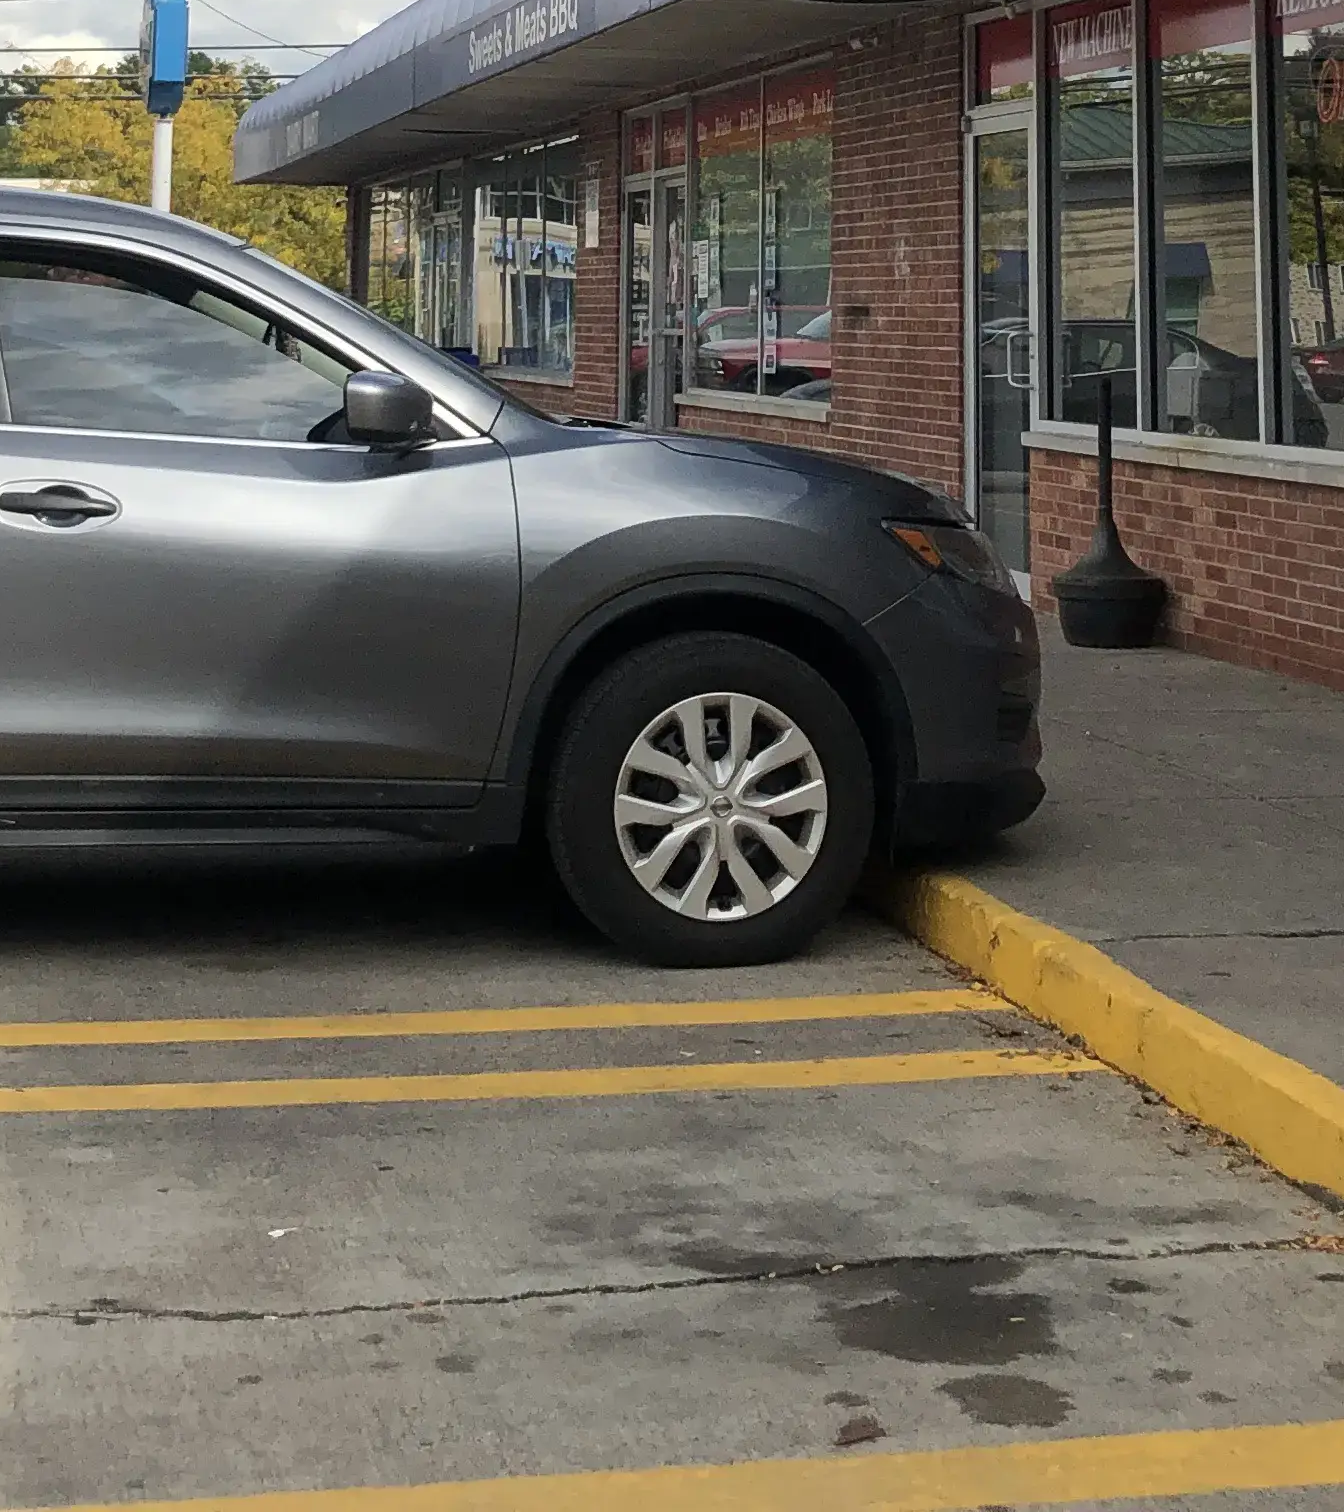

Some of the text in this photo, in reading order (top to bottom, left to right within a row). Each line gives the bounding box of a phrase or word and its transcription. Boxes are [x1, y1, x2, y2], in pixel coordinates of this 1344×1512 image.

[468, 21, 502, 74] Sweets
[505, 11, 513, 57] &
[515, 0, 547, 53] Meats
